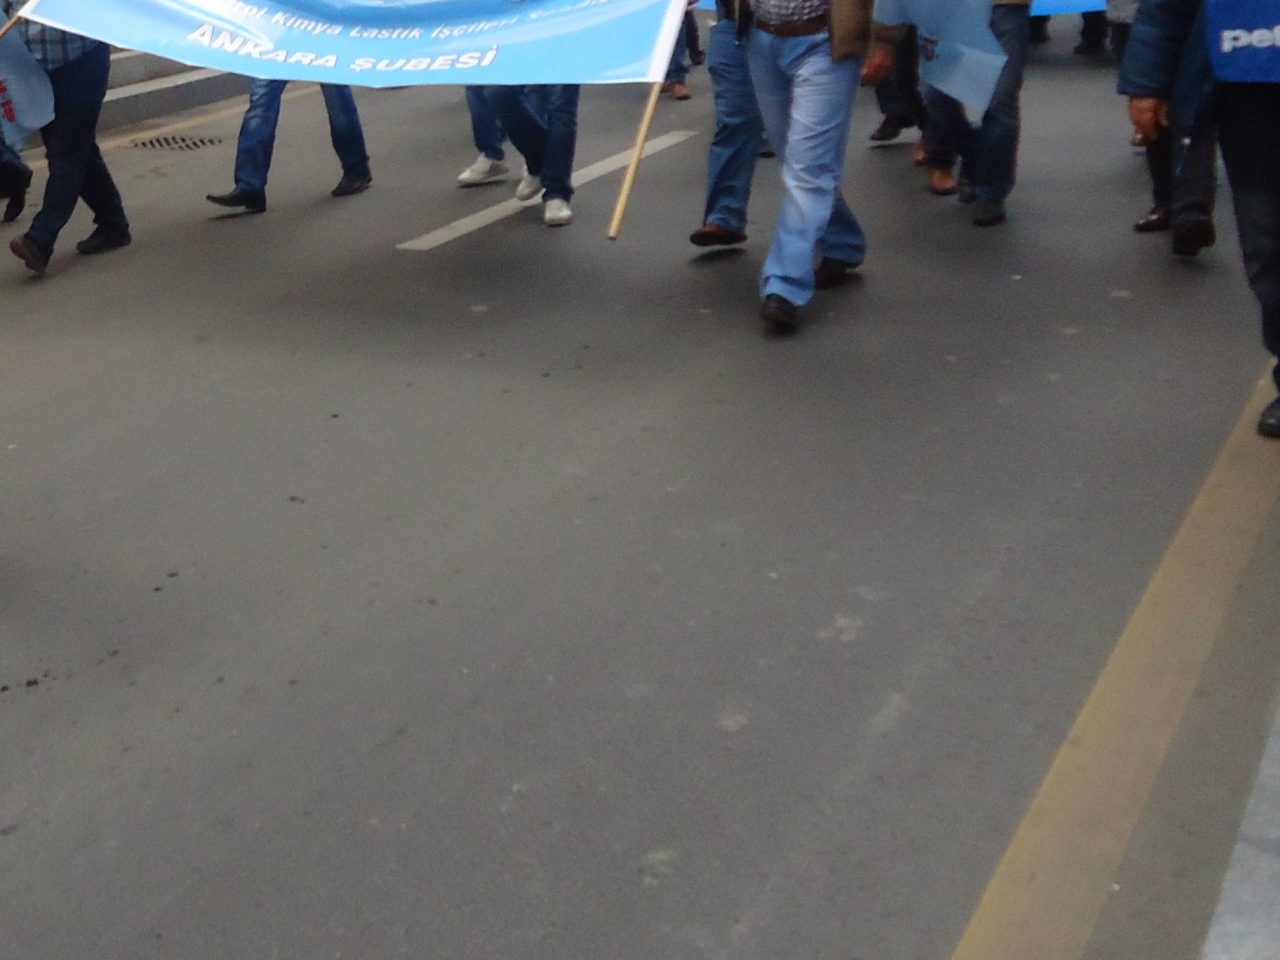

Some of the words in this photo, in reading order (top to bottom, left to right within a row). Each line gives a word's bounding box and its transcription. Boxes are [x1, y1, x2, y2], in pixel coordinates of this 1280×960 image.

[272, 10, 343, 37] Kimya
[349, 25, 423, 40] Lastik
[186, 23, 339, 69] ANKARA
[349, 44, 499, 73] ŞUBESİ
